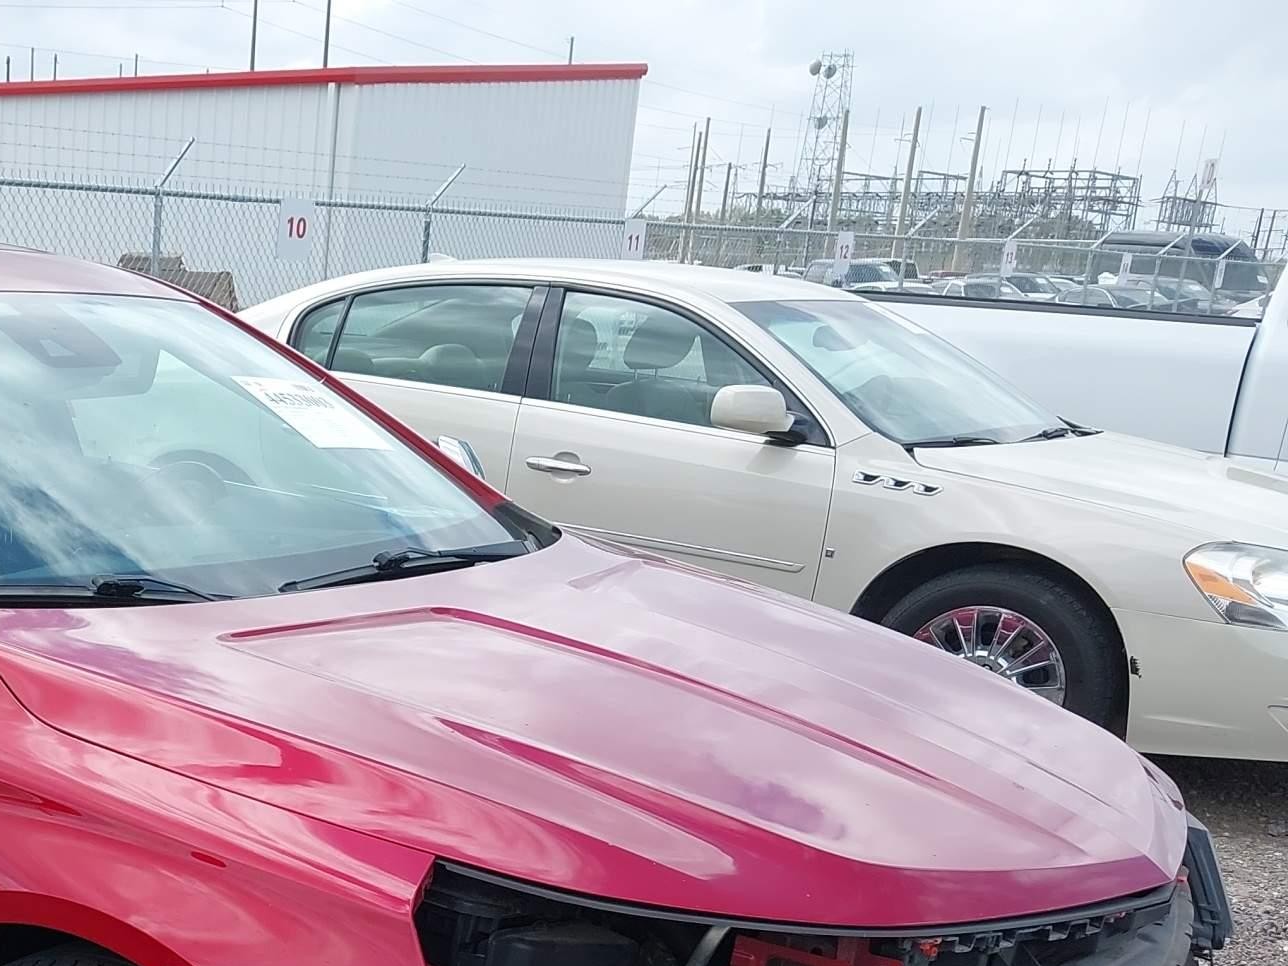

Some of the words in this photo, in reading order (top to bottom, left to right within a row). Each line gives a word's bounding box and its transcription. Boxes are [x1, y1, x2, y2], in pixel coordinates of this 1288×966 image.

[287, 216, 307, 239] 10
[628, 233, 640, 251] 11
[839, 244, 850, 259] 12
